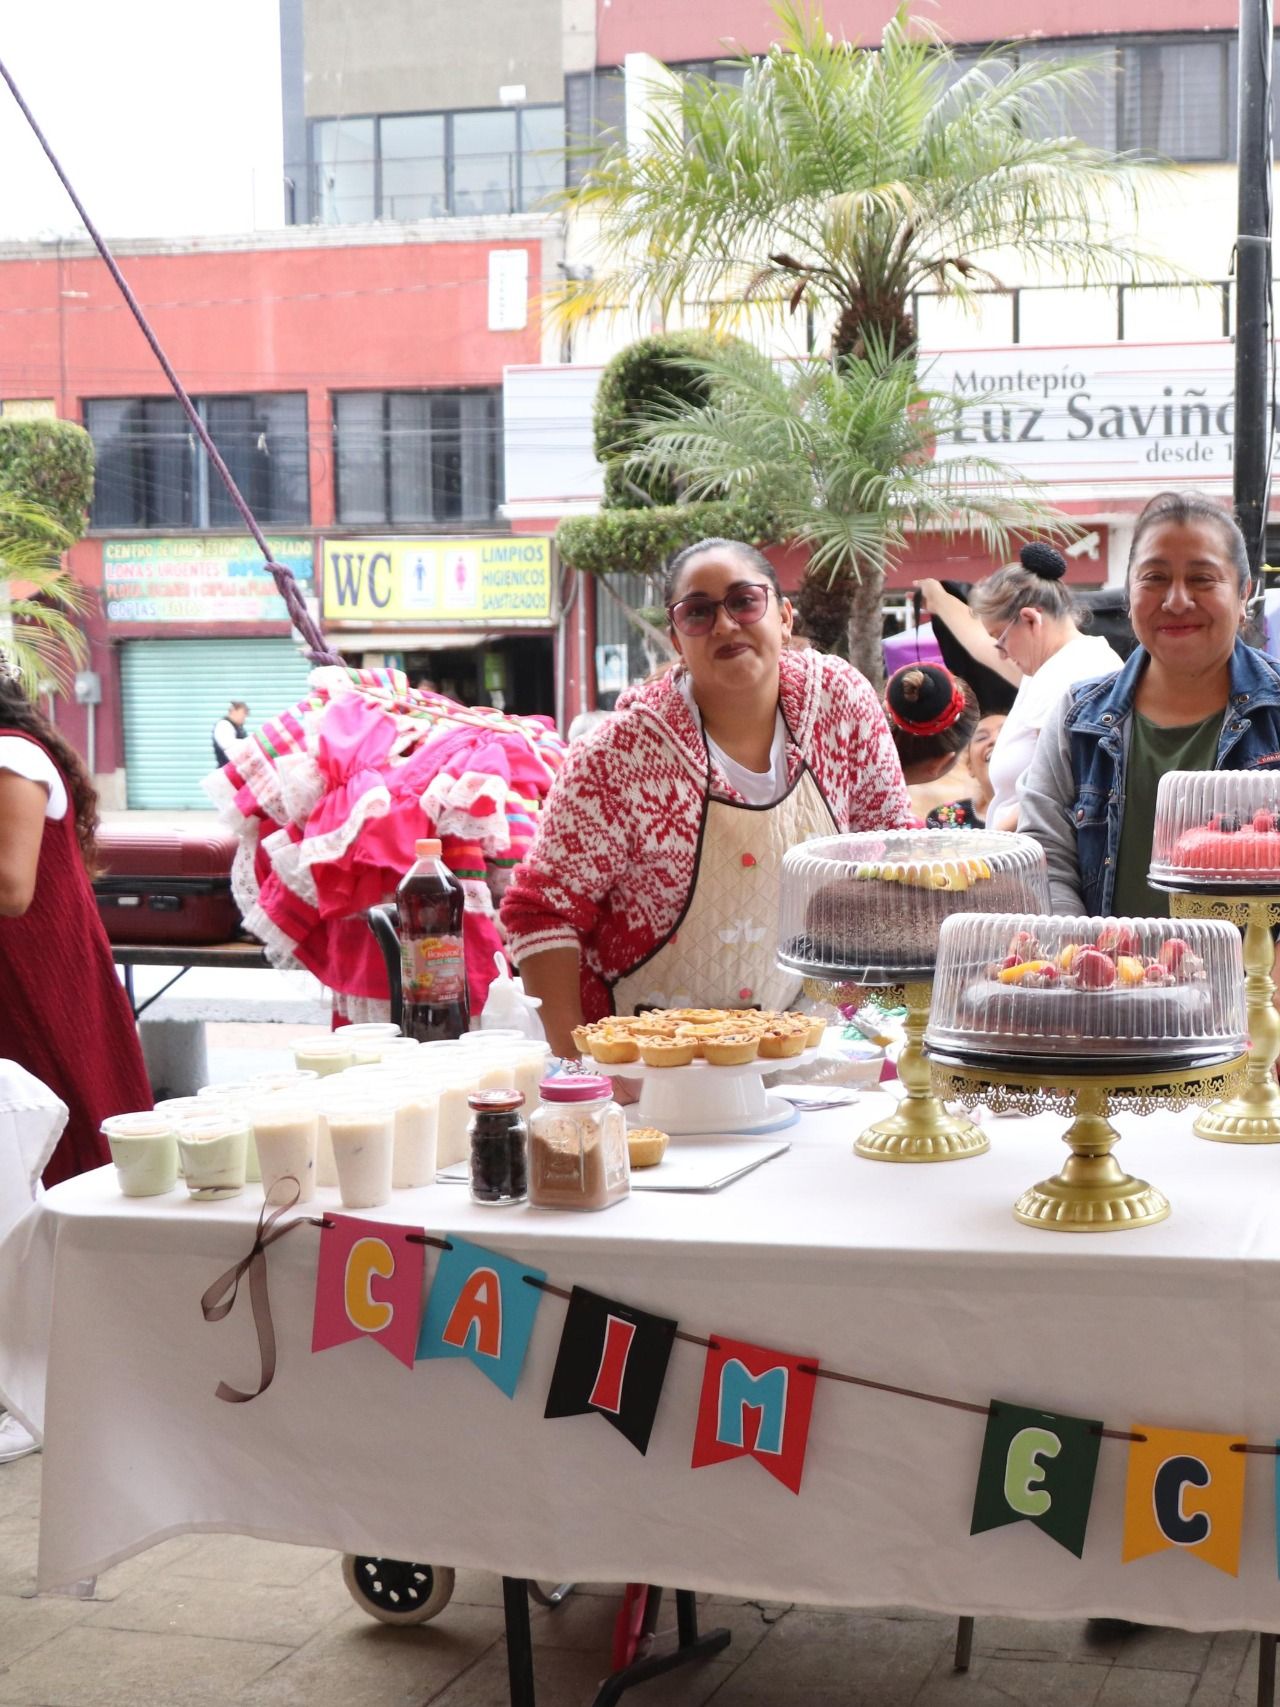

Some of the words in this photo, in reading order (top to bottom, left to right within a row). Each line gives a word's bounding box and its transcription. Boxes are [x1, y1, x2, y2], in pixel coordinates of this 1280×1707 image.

[953, 364, 1086, 398] Montepío
[953, 398, 1045, 442] Luz
[1146, 440, 1213, 463] desde
[106, 543, 153, 559] CENTRO
[481, 545, 544, 563] LIMPIOS
[105, 561, 153, 579] LONAS
[330, 552, 391, 608] WC
[481, 568, 545, 586] HIGIENICOS
[344, 1236, 789, 1456] CAIM
